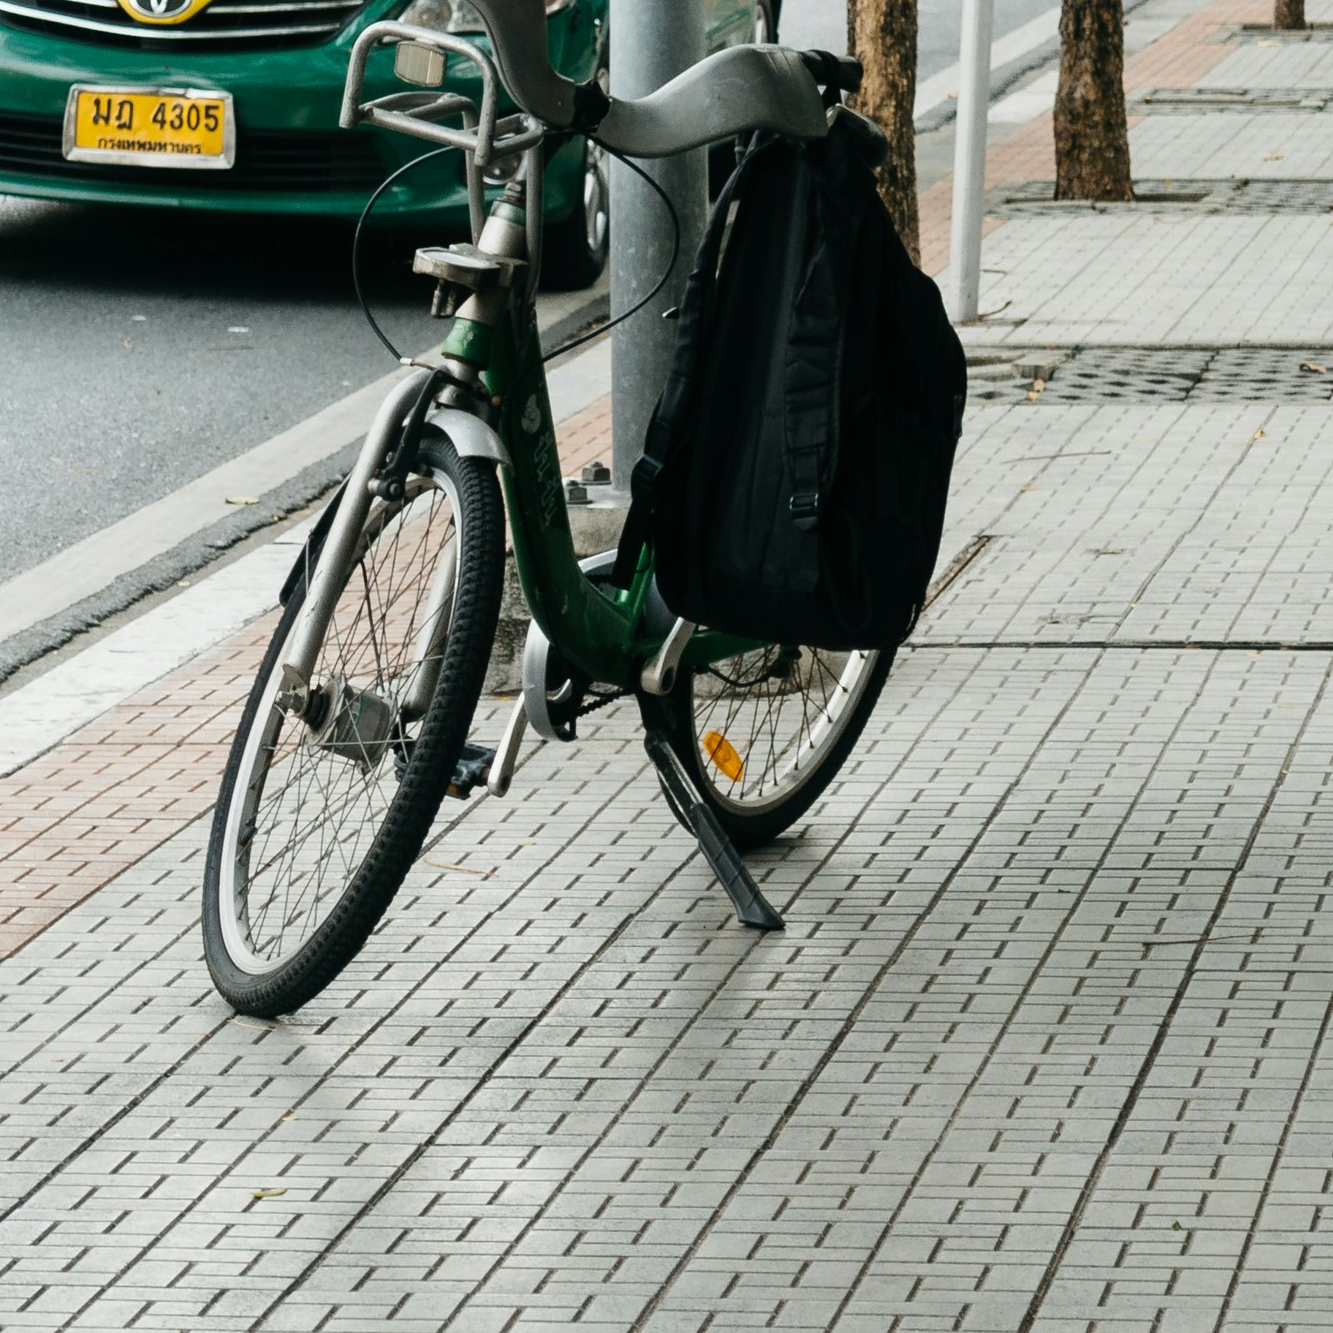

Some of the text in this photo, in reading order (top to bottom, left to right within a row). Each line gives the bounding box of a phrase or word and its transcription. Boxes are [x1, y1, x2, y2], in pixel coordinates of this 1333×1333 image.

[151, 102, 219, 132] 4305
[98, 138, 202, 154] กรงเทพมหานคร
